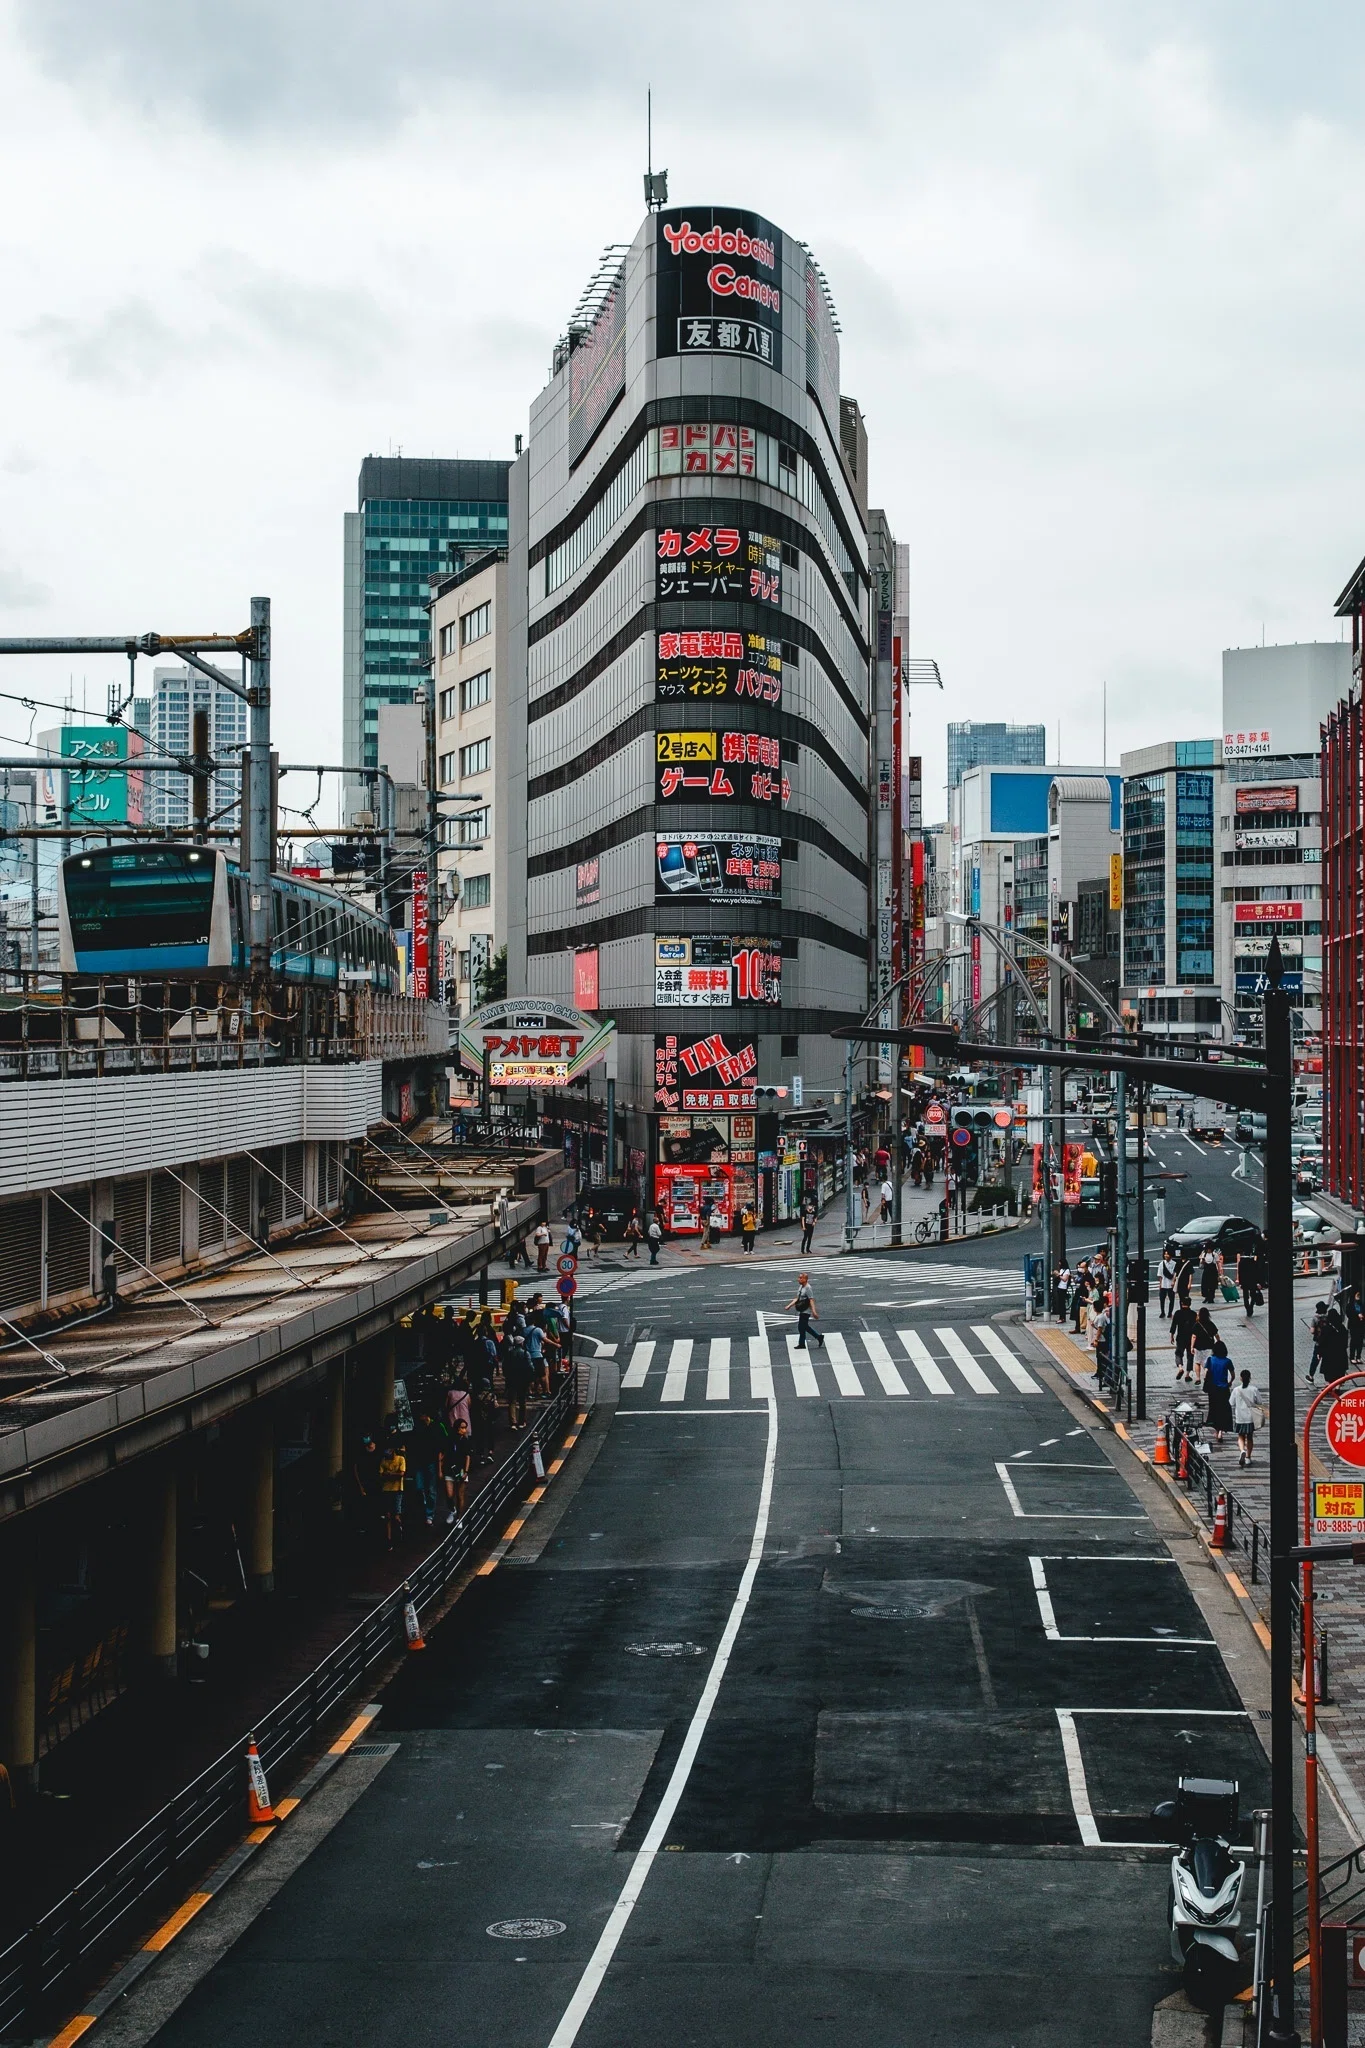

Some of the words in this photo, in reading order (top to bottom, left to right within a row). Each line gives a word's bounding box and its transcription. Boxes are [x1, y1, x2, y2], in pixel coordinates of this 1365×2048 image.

[664, 221, 776, 270] Yodobashi
[707, 264, 780, 314] Camera
[686, 320, 770, 358] 友都八喜
[661, 425, 755, 449] ヨドバシ
[686, 451, 755, 474] カメラ
[658, 527, 741, 558] カメラ
[691, 561, 745, 575] ドライヤー
[660, 576, 743, 596] シェーバー
[750, 568, 779, 604] テレビ
[659, 631, 744, 660] 家電製品
[658, 665, 728, 681] スーツケース
[658, 684, 686, 696] マウス
[689, 681, 727, 695] インク
[734, 668, 781, 703] パソコン
[70, 740, 118, 757] アメ横
[658, 735, 713, 760] 2号店へ
[1224, 731, 1270, 745] 広告募集
[1224, 743, 1271, 755] 03-3471-4141
[722, 732, 780, 769] 携帯電話
[661, 767, 734, 797] ゲーム
[72, 793, 111, 811] ビル
[196, 936, 209, 944] JR
[880, 919, 889, 953] NUOVO
[657, 970, 683, 980] 入会金
[688, 969, 730, 991] 無料
[657, 981, 683, 992] 年会費
[657, 993, 730, 1004] 店頭にてすぐ発行
[480, 1000, 580, 1022] AMEYAYOKOCHO
[482, 1035, 584, 1058] アメヤ横丁
[679, 1033, 732, 1077] TAX
[656, 1048, 666, 1086] カメラ
[665, 1035, 678, 1086] ヨドバシ
[715, 1043, 757, 1087] FREE
[561, 1260, 573, 1270] 30
[1340, 1398, 1357, 1408] FIRE
[1317, 1484, 1363, 1499] 中国語
[1324, 1501, 1356, 1516] 対応
